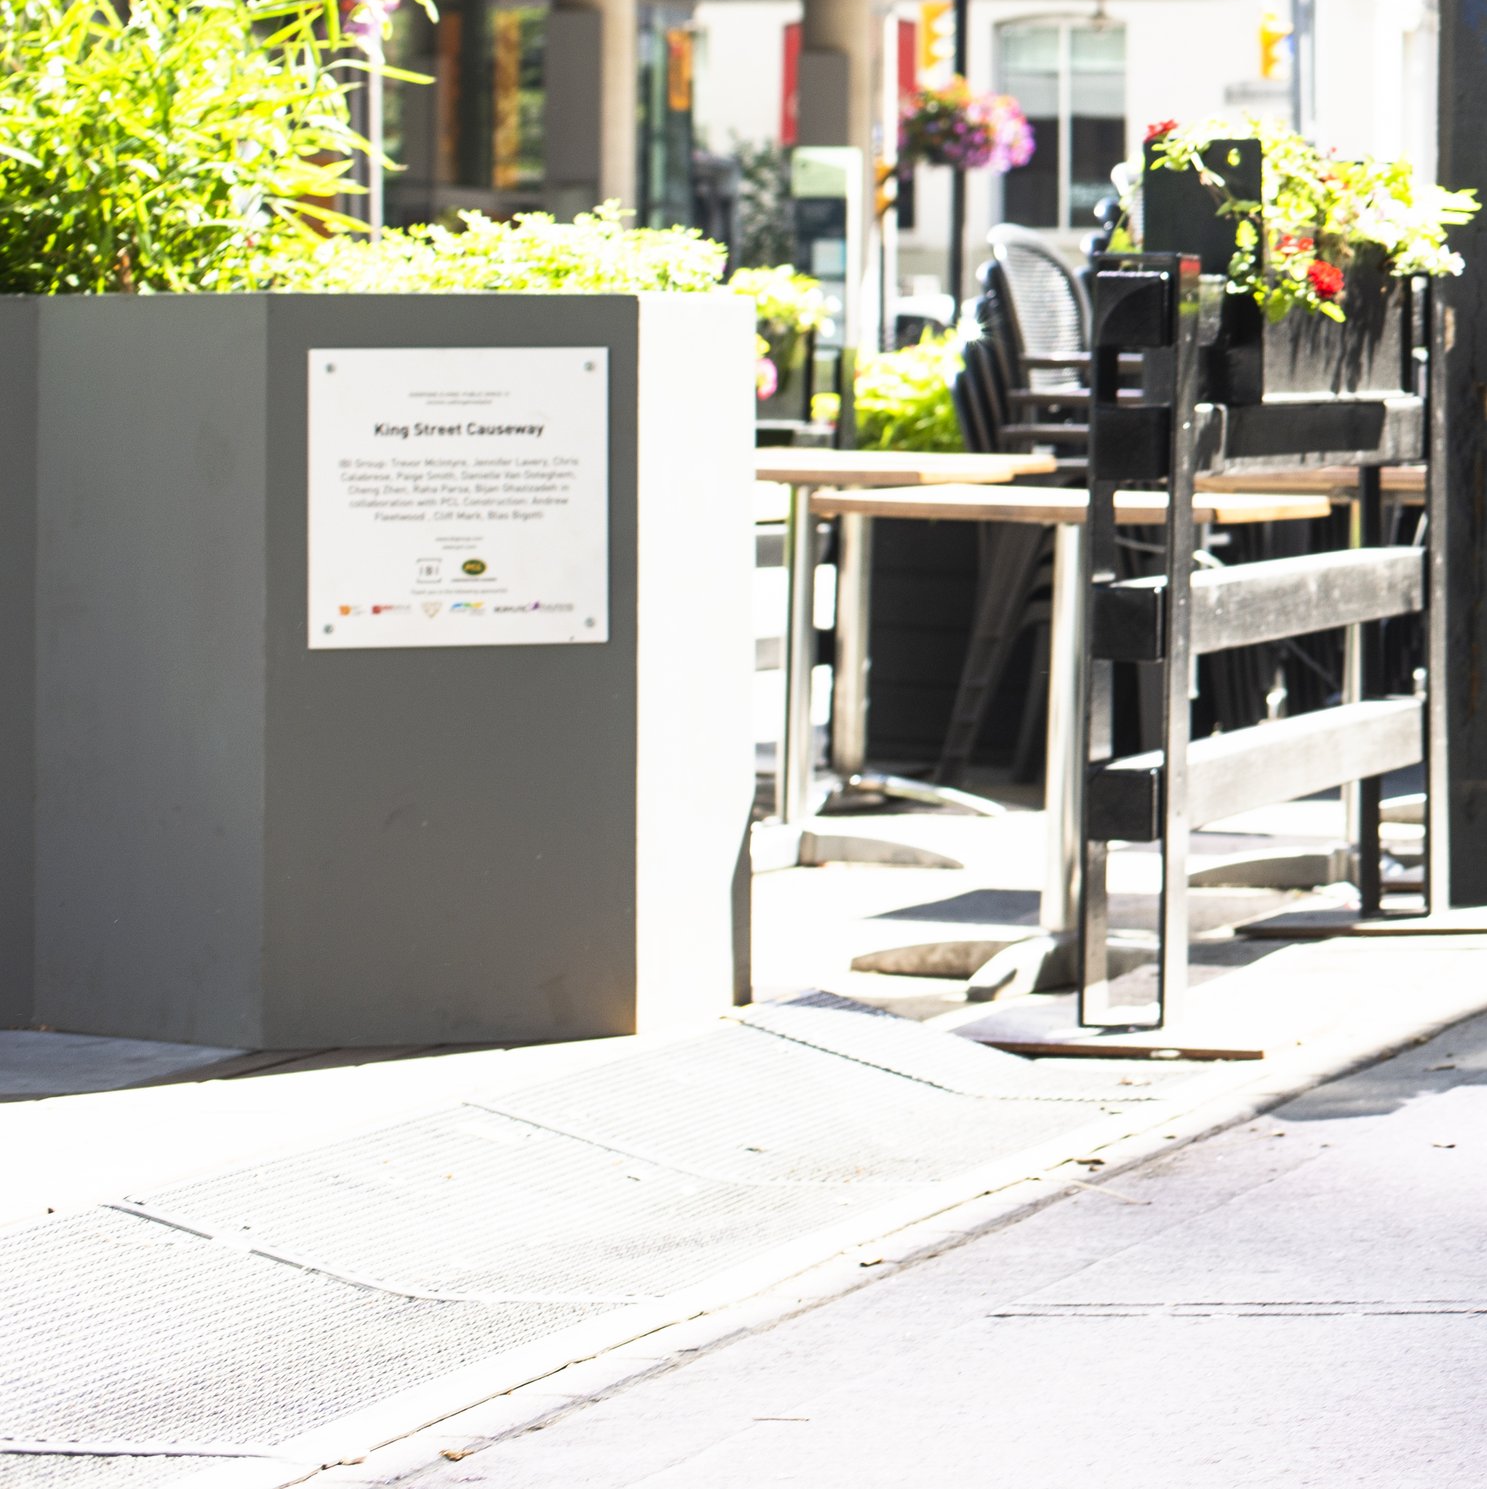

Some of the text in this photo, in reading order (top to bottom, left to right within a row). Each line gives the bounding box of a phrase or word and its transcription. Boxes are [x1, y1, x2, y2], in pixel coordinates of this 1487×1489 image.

[374, 421, 544, 439] King Street Causeway
[349, 498, 415, 509] collaboration
[417, 497, 437, 507] with
[531, 496, 568, 506] Andrew
